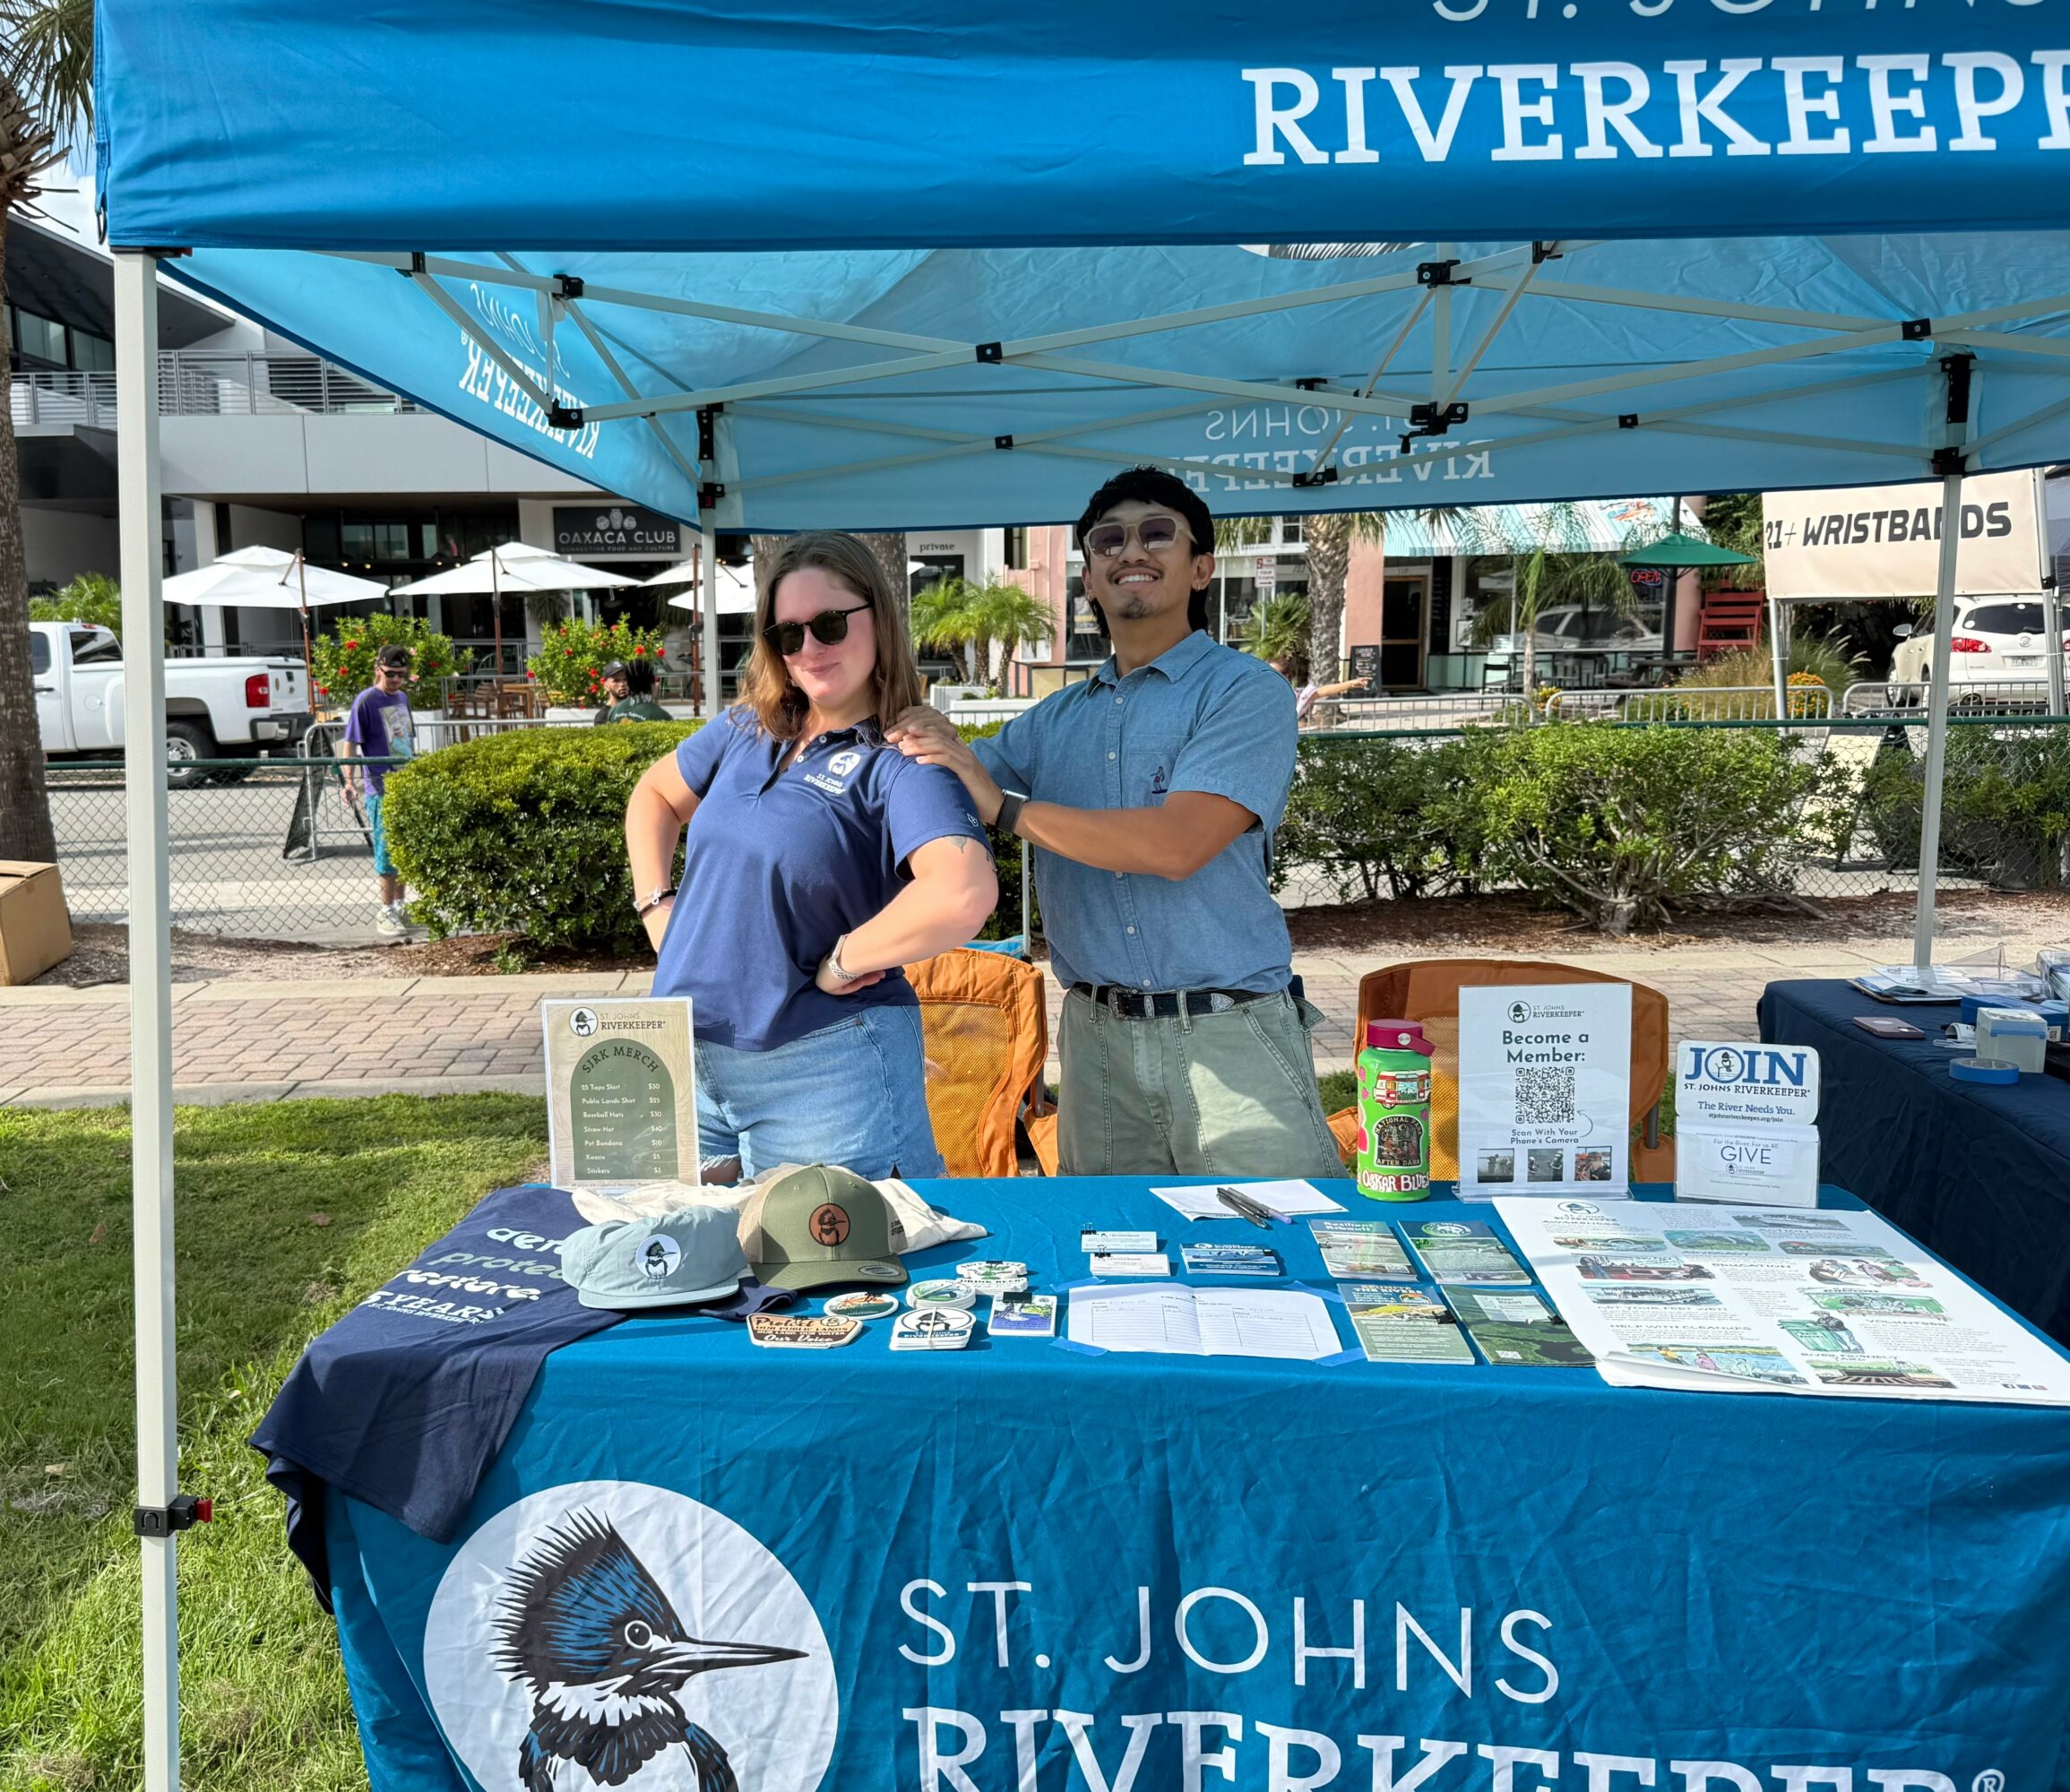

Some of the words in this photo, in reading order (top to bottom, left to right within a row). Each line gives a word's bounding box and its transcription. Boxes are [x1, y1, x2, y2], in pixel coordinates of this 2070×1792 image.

[559, 532, 626, 544] OAXACA
[634, 530, 676, 543] CLUB
[919, 543, 955, 554] private
[1631, 571, 1661, 583] OPEN
[1502, 1030, 1572, 1045] Become
[1578, 1033, 1589, 1044] a
[582, 1048, 610, 1073] SJRK
[614, 1046, 660, 1073] MERCH
[1506, 1047, 1585, 1063] Member:
[1685, 1047, 1807, 1086] JOIN
[590, 1083, 605, 1092] Taps
[1698, 1083, 1731, 1092] JOHNS
[1697, 1101, 1716, 1110] The
[1718, 1103, 1743, 1112] River
[1746, 1104, 1774, 1115] Needs
[1776, 1106, 1795, 1116] You.
[651, 1124, 663, 1133] $40
[1375, 1116, 1409, 1134] NATIONAL
[1535, 1128, 1555, 1136] With
[1558, 1128, 1578, 1136] Your
[1510, 1137, 1542, 1145] Phone's
[1721, 1145, 1772, 1164] GIVE
[1362, 1169, 1398, 1193] OSKAR
[898, 1578, 1052, 1668] ST.
[1103, 1586, 1560, 1703] JOHNS
